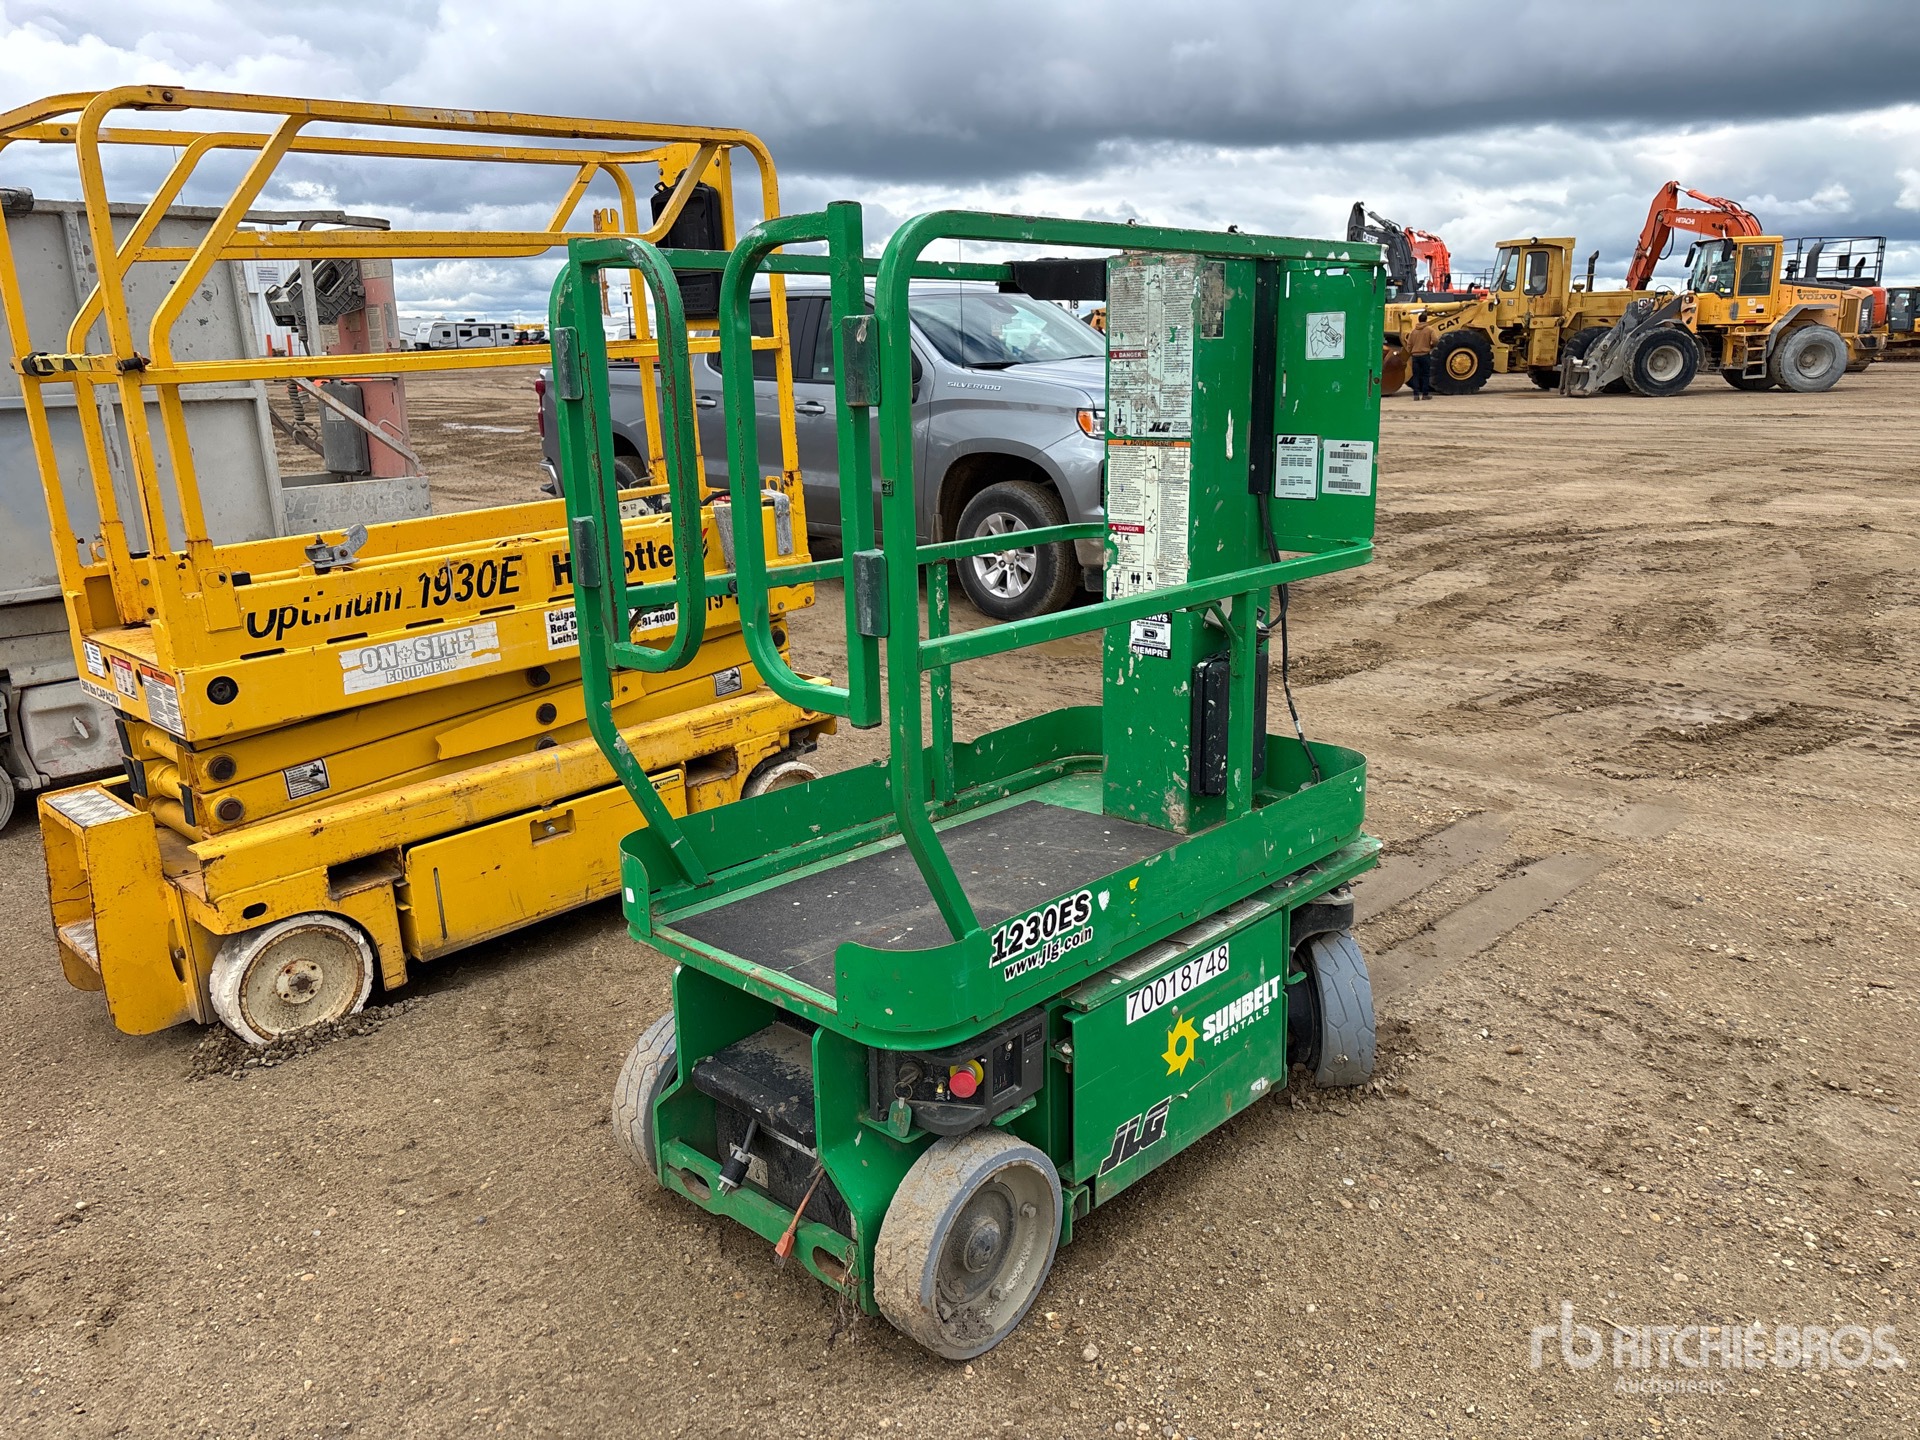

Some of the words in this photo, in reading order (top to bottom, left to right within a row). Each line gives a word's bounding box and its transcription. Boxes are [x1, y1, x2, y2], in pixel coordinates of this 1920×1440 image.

[1675, 217, 1696, 225] HITACHI
[1437, 316, 1460, 331] CAT
[947, 382, 1002, 391] SILVERADO
[1148, 422, 1172, 433] JLG
[1279, 437, 1297, 445] JLG
[418, 554, 523, 609] 1930E
[550, 621, 568, 634] Red
[359, 643, 398, 673] ON
[412, 628, 476, 661] SITE
[1132, 645, 1168, 658] SIEMPRE
[386, 656, 458, 683] EQUIPMENT
[991, 892, 1091, 966] 1230ES
[1128, 945, 1228, 1021] 70018748
[1202, 975, 1280, 1042] SUNBELT
[1213, 1005, 1270, 1046] RENTALS
[1098, 1095, 1172, 1178] JLG
